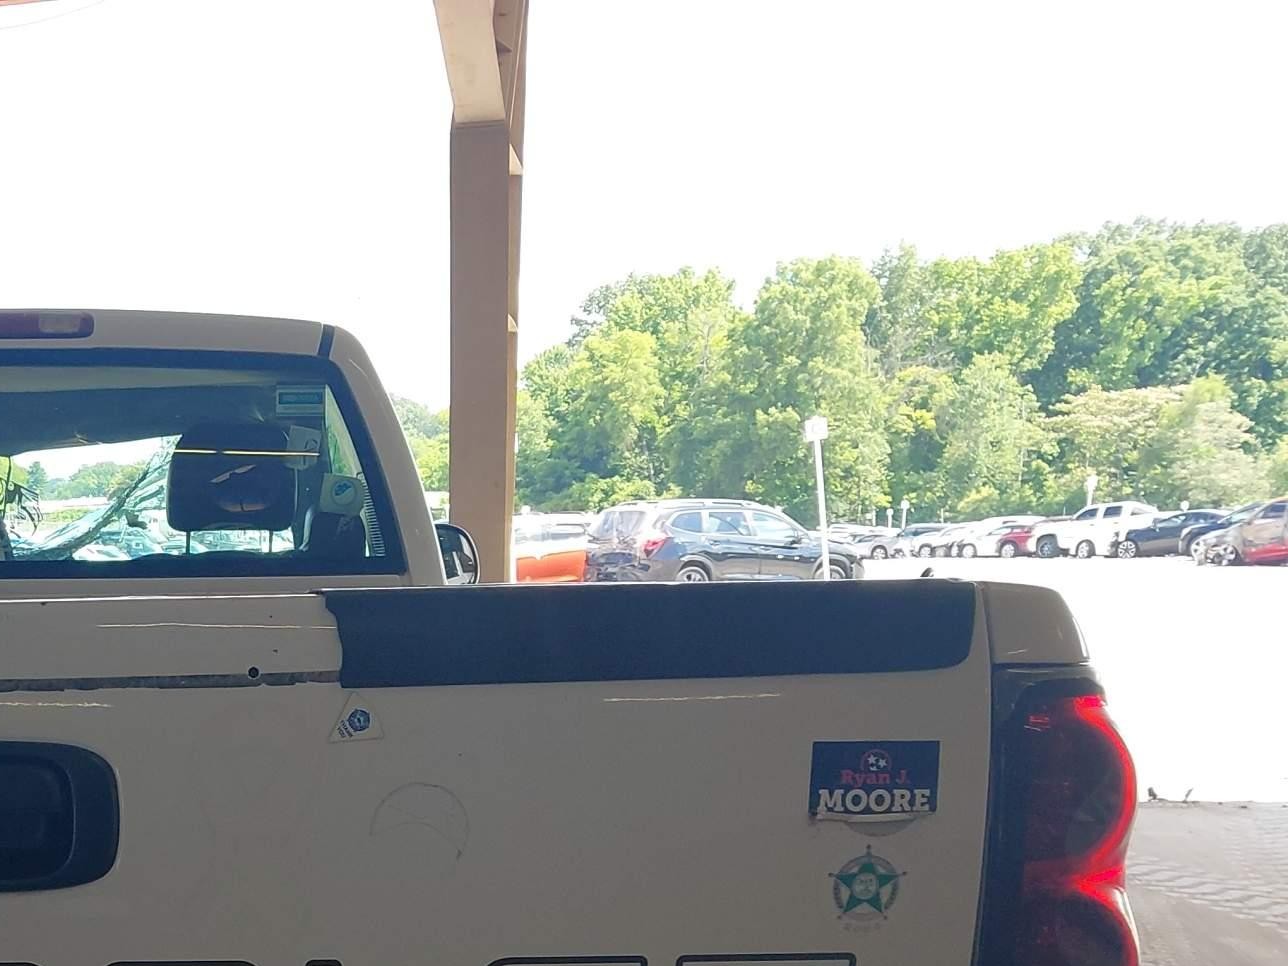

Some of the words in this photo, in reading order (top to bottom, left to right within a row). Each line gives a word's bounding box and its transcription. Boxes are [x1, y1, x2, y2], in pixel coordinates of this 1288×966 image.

[840, 768, 891, 787] Ryan
[895, 768, 911, 785] J.
[816, 788, 931, 813] MOORE
